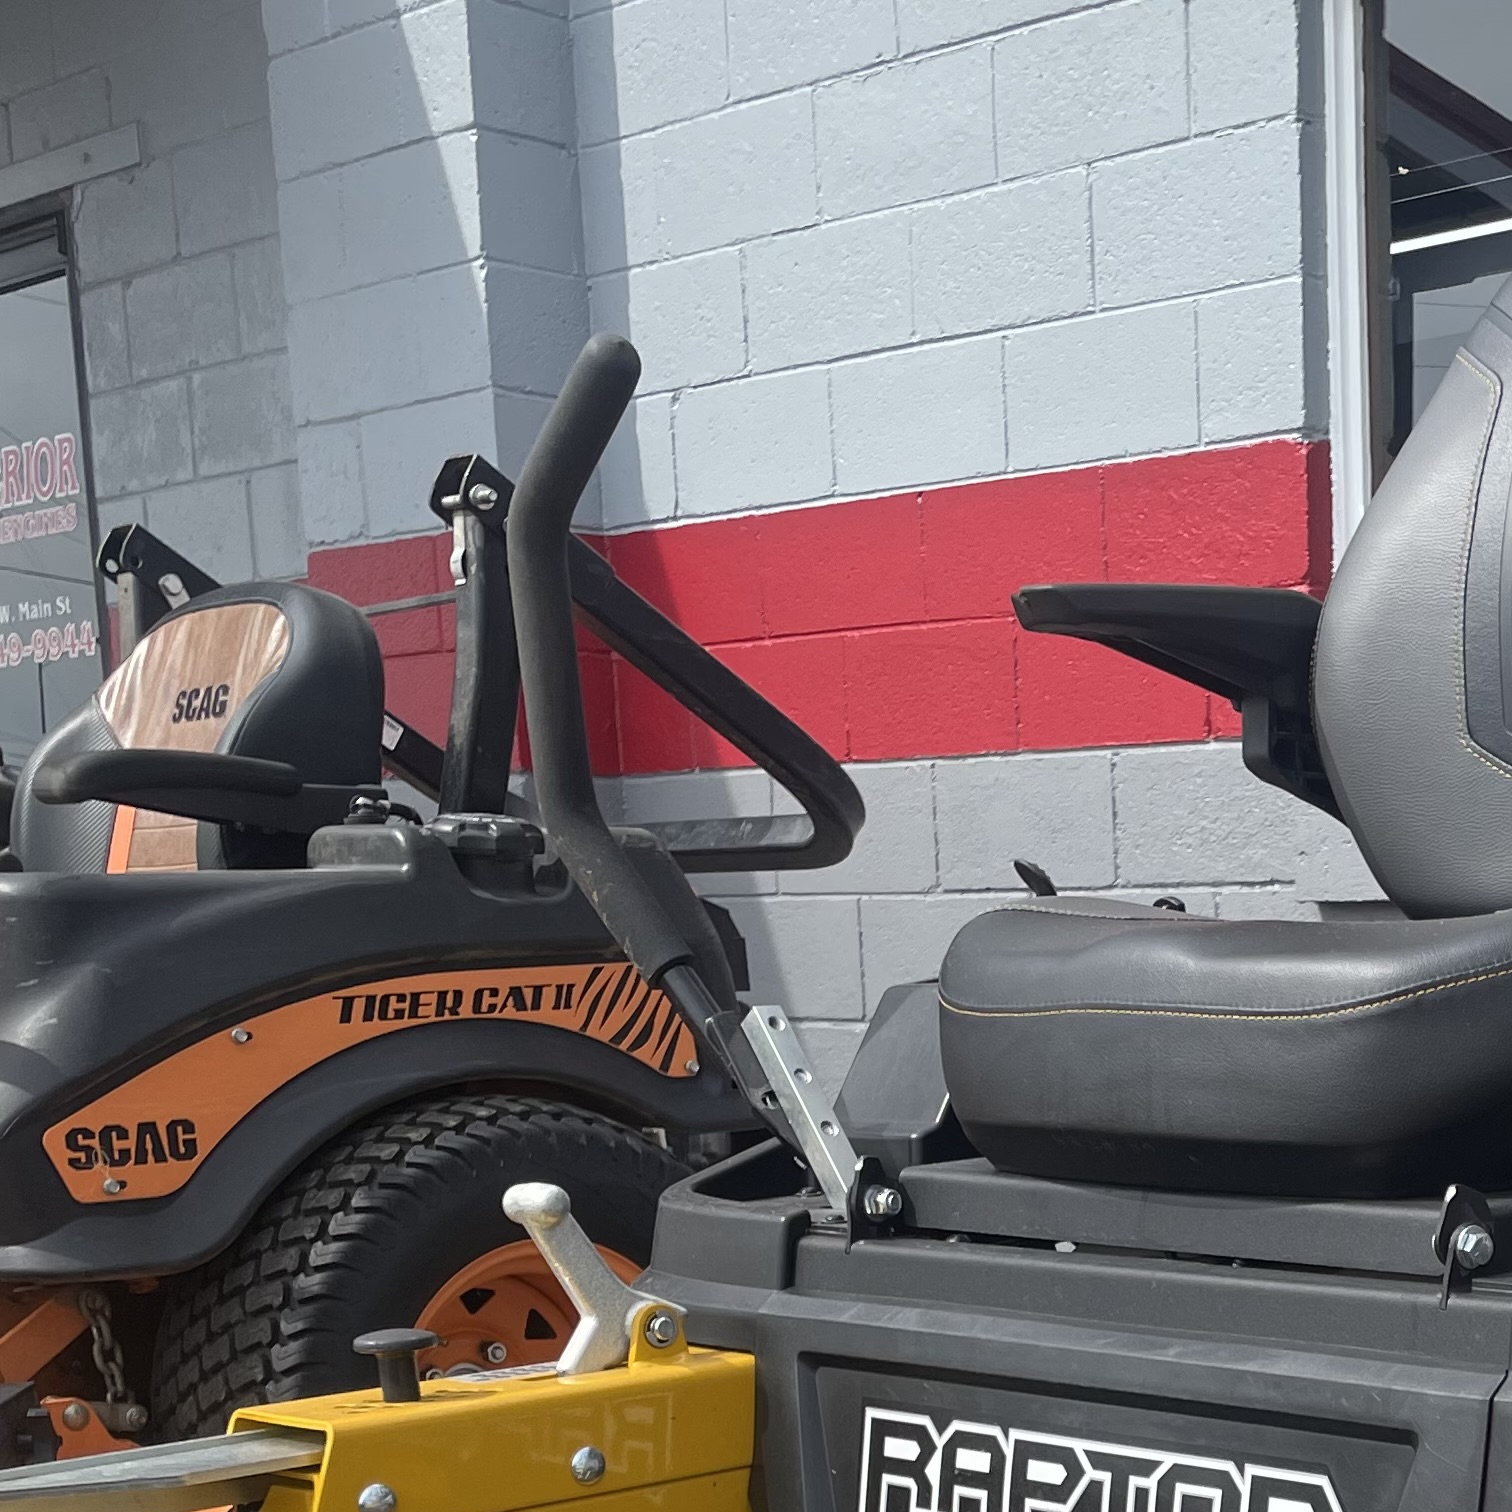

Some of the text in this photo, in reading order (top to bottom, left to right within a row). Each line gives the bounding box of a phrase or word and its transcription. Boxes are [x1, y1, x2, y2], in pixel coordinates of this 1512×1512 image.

[0, 432, 80, 511] RIOR
[18, 600, 52, 621] Main
[56, 595, 72, 615] St
[172, 684, 230, 724] SCAG
[332, 987, 464, 1024] TIGER
[472, 985, 554, 1017] CAT
[65, 1119, 198, 1171] SCAG
